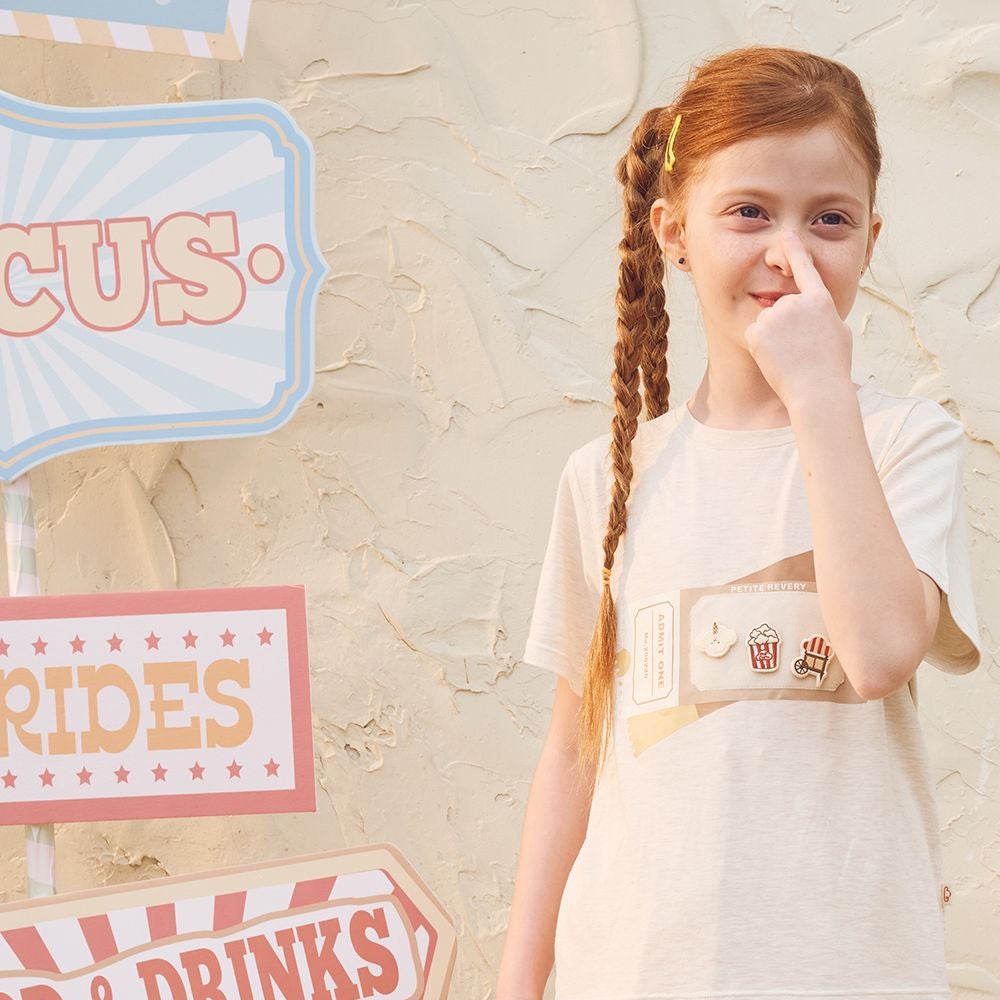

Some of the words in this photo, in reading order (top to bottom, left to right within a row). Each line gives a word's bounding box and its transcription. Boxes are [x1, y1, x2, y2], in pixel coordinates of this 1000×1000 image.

[730, 584, 765, 593] PETITE
[767, 582, 806, 591] REVERY
[0, 658, 254, 757] RIDES
